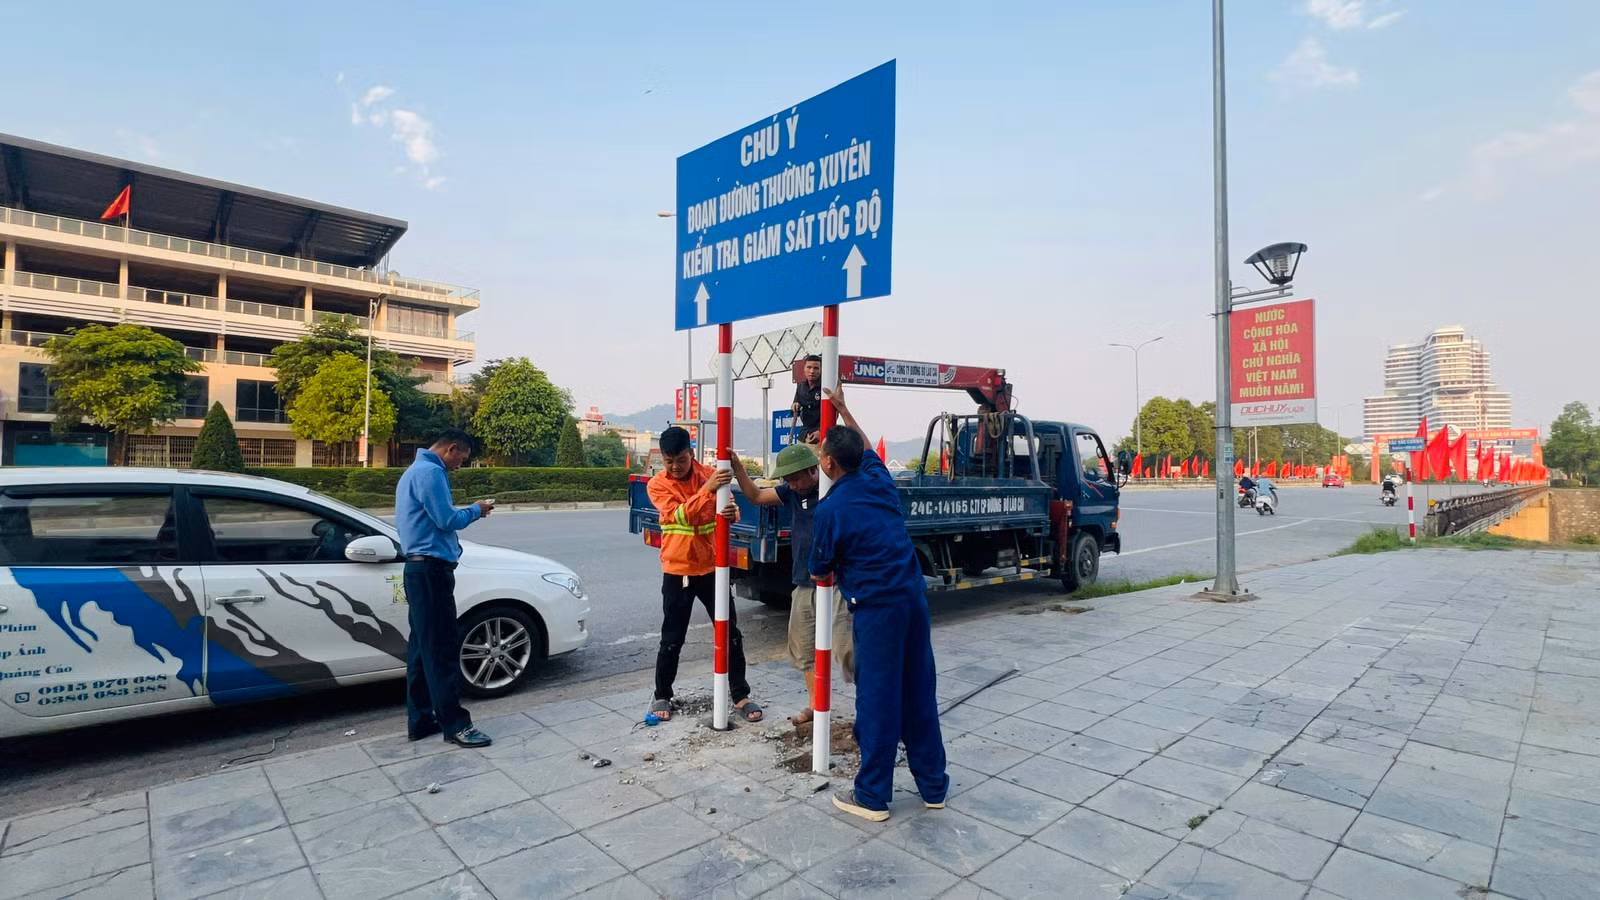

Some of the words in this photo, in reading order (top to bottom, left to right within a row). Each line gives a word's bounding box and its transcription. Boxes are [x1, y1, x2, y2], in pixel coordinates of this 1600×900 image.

[741, 113, 780, 168] CHÚ
[785, 105, 800, 150] Ý
[687, 197, 717, 235] ĐOẠN
[719, 180, 760, 223] ĐƯỜNG
[761, 161, 815, 209] THƯỜNG
[818, 137, 872, 191] XUYÊN
[683, 235, 714, 280] KIỂM
[715, 237, 740, 271] TRA
[743, 221, 783, 265] GIÁM
[784, 210, 815, 253] SÁT
[817, 195, 850, 245] TỐC
[855, 188, 882, 239] ĐỘ
[1255, 308, 1286, 323] NƯỚC
[1243, 326, 1273, 341] CỘNG
[1275, 321, 1299, 335] HÒA
[1252, 340, 1267, 353] XÃ
[1270, 337, 1289, 352] HỘI
[1242, 353, 1264, 369] CHỦ
[1266, 351, 1301, 366] NGHĨA
[854, 361, 885, 378] UNIC
[1246, 369, 1268, 384] VIỆT
[1271, 368, 1297, 380] NAM
[1239, 384, 1271, 398] MUÔN
[1274, 382, 1304, 395] NĂM!
[44, 663, 73, 674] Cáo
[38, 683, 88, 695] 0915
[133, 673, 167, 684] 688
[37, 693, 89, 705] 0386
